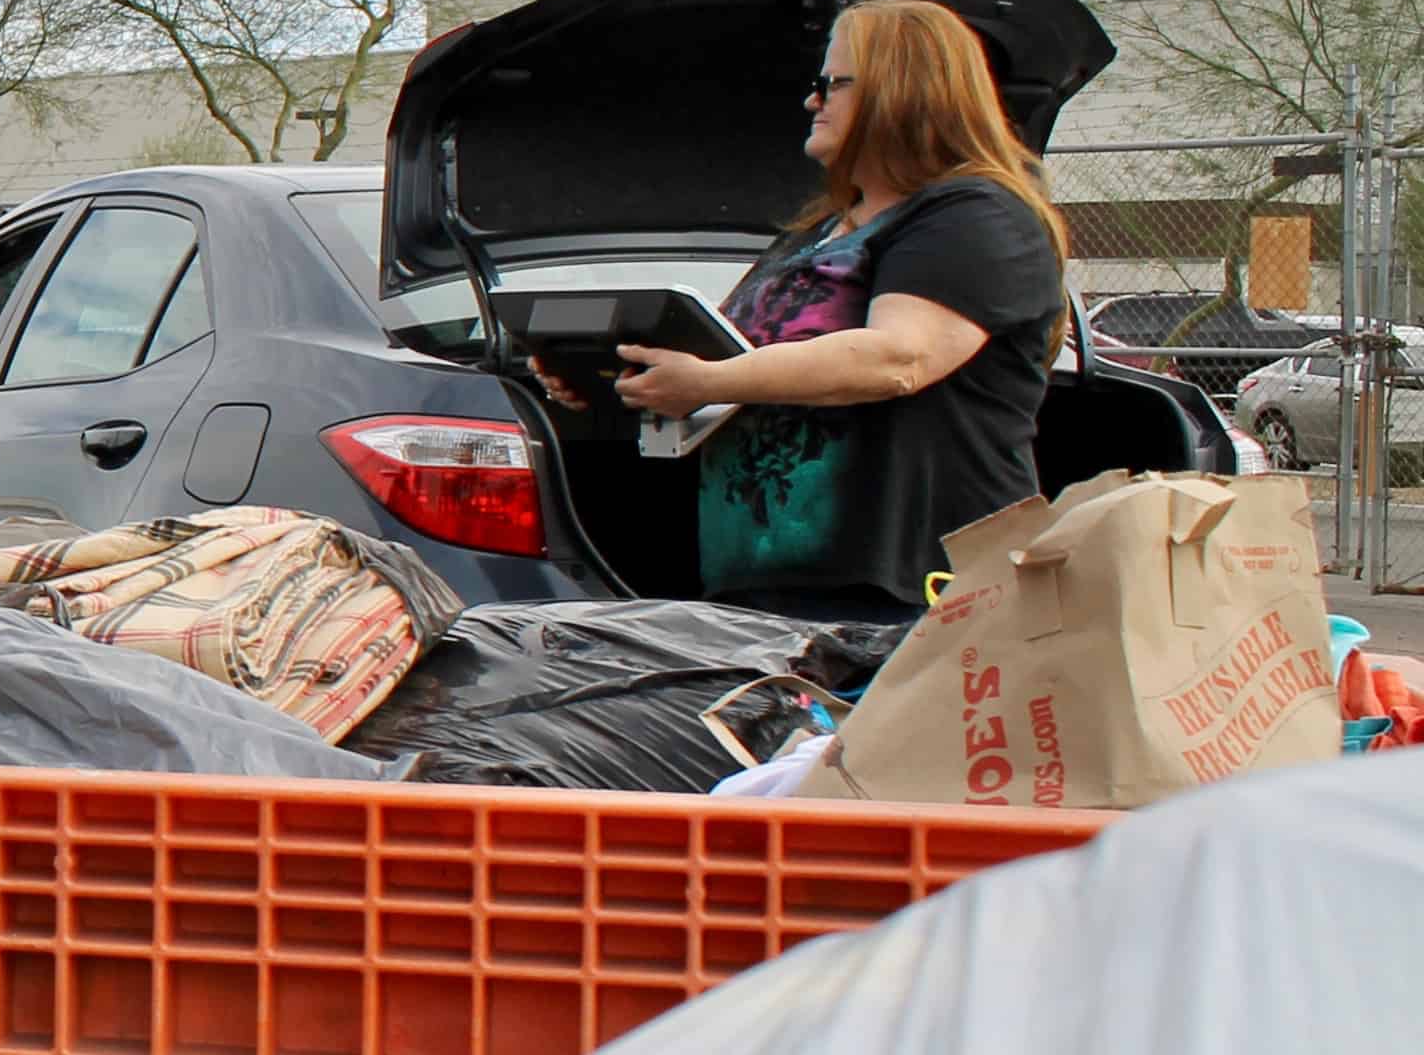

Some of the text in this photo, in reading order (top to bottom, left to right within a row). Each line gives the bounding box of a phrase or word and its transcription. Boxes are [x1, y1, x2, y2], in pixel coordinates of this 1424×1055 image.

[1162, 611, 1293, 737] REUSABLE
[1182, 649, 1334, 784] RECYCLABLE
[1029, 694, 1065, 808] OES.com
